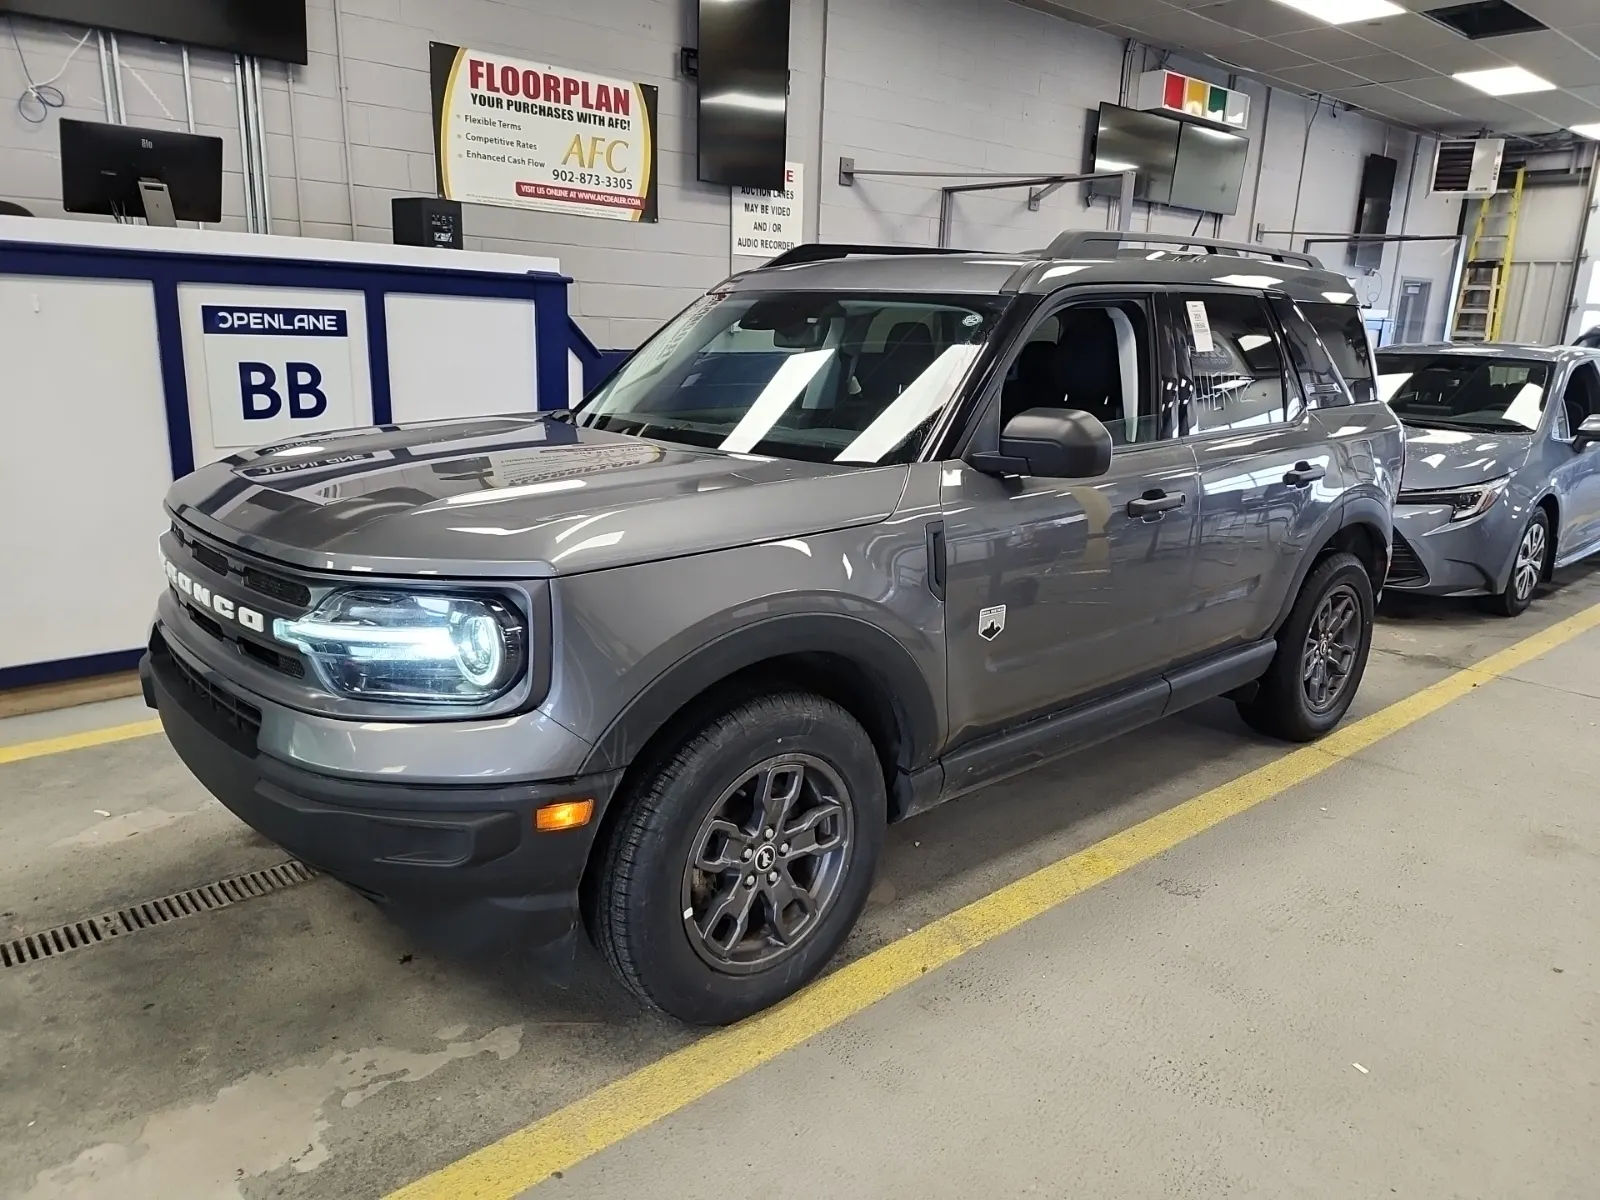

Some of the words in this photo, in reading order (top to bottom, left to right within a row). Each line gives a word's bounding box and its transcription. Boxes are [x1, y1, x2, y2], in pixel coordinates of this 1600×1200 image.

[469, 59, 630, 116] FLOORPLAN
[470, 92, 503, 109] YOUR
[506, 99, 574, 121] PURCHASES
[576, 111, 606, 127] WITH
[607, 117, 631, 131] AFC!
[464, 114, 497, 127] Flexible
[498, 119, 522, 131] Terms
[465, 132, 515, 147] Competitive
[516, 139, 537, 150] Rates
[466, 149, 506, 163] Enhanced
[507, 155, 526, 166] Cash
[527, 158, 546, 168] Flow
[561, 133, 629, 174] AFC
[552, 168, 633, 190] 902-873-3305
[520, 184, 536, 194] VISIT
[536, 186, 546, 195] US
[546, 188, 569, 198] ONLINE
[569, 190, 577, 198] AT
[577, 191, 641, 206] WWW.AFCDEALER.COM
[741, 187, 771, 197] AUCTION
[744, 202, 759, 213] MAY
[760, 204, 769, 214] BE
[771, 205, 791, 217] VIDEO
[753, 221, 768, 232] AND
[772, 223, 782, 233] OR
[737, 237, 758, 248] AUDIO
[760, 240, 795, 251] RECORDED
[217, 311, 338, 331] OPENLANE
[238, 361, 328, 420] BB
[163, 556, 264, 633] RONCO
